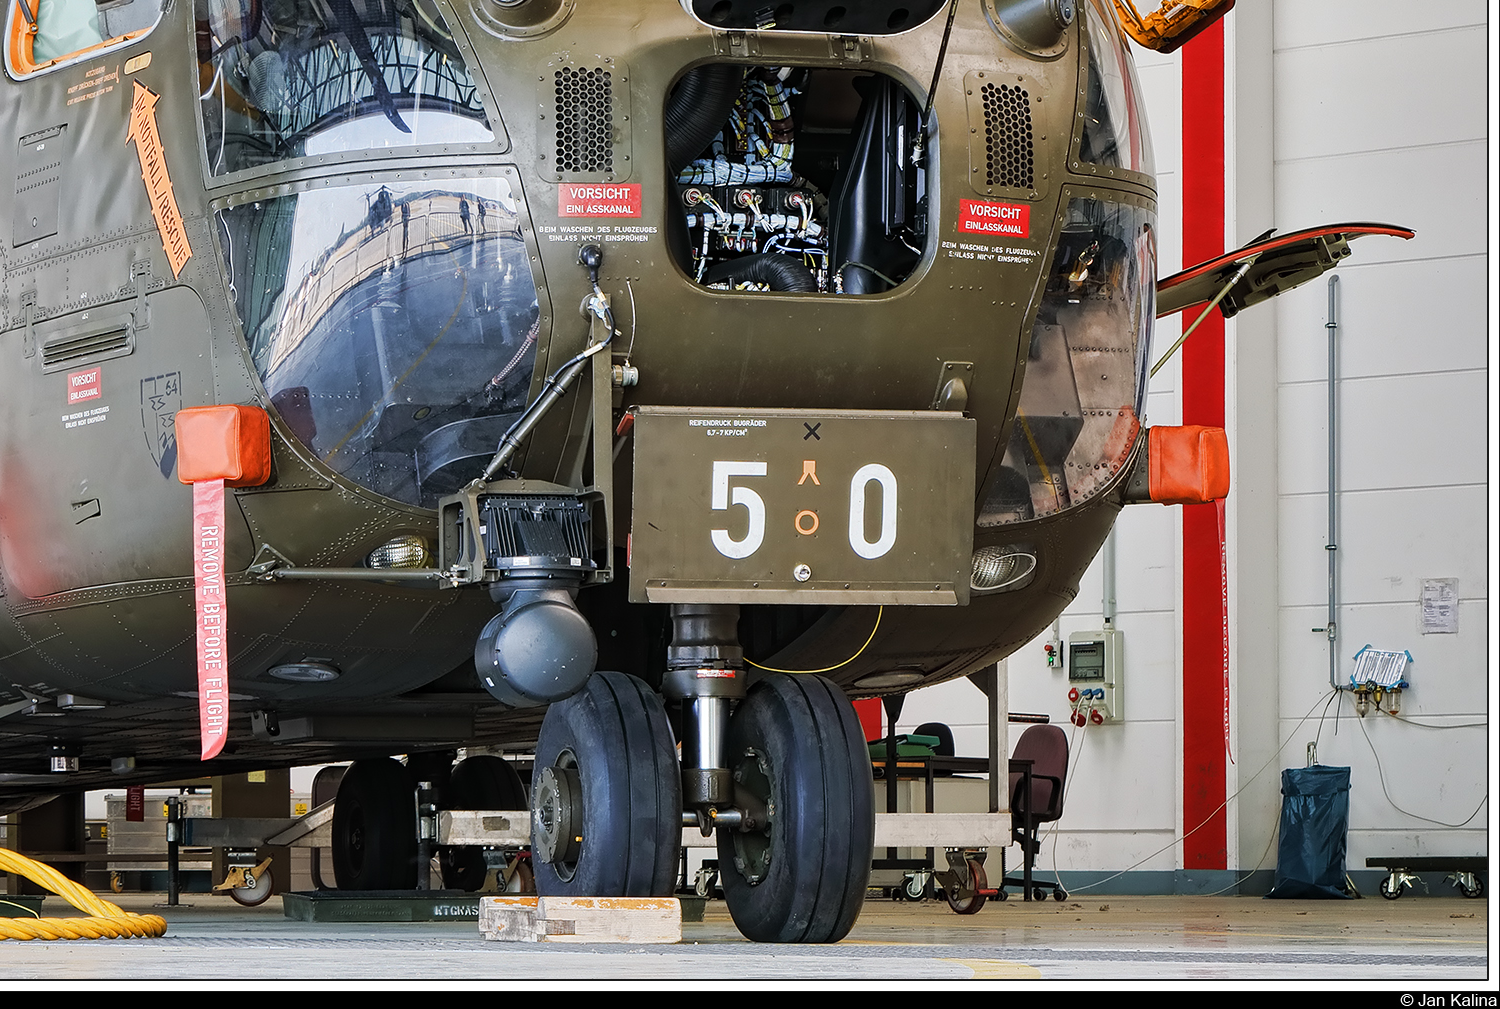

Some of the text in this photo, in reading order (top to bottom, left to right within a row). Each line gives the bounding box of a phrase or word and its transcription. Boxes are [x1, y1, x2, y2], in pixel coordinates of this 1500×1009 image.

[569, 187, 631, 200] VORSICHT
[566, 205, 634, 214] EINLASSKANAL
[969, 204, 1022, 220] VORSICHT
[614, 226, 658, 234] FLUGZEUGES
[965, 220, 1024, 234] EINLASSKANAL
[605, 234, 649, 242] EINSPRÜHEN
[959, 243, 989, 253] WASCHEN
[71, 372, 97, 387] VORSICHT
[688, 419, 767, 427] REIFENDRUCK BUGRÄDER
[710, 461, 767, 559] 5
[201, 525, 223, 736] REMOVE BEFORE FLIGHT
[130, 784, 141, 811] LIGHT
